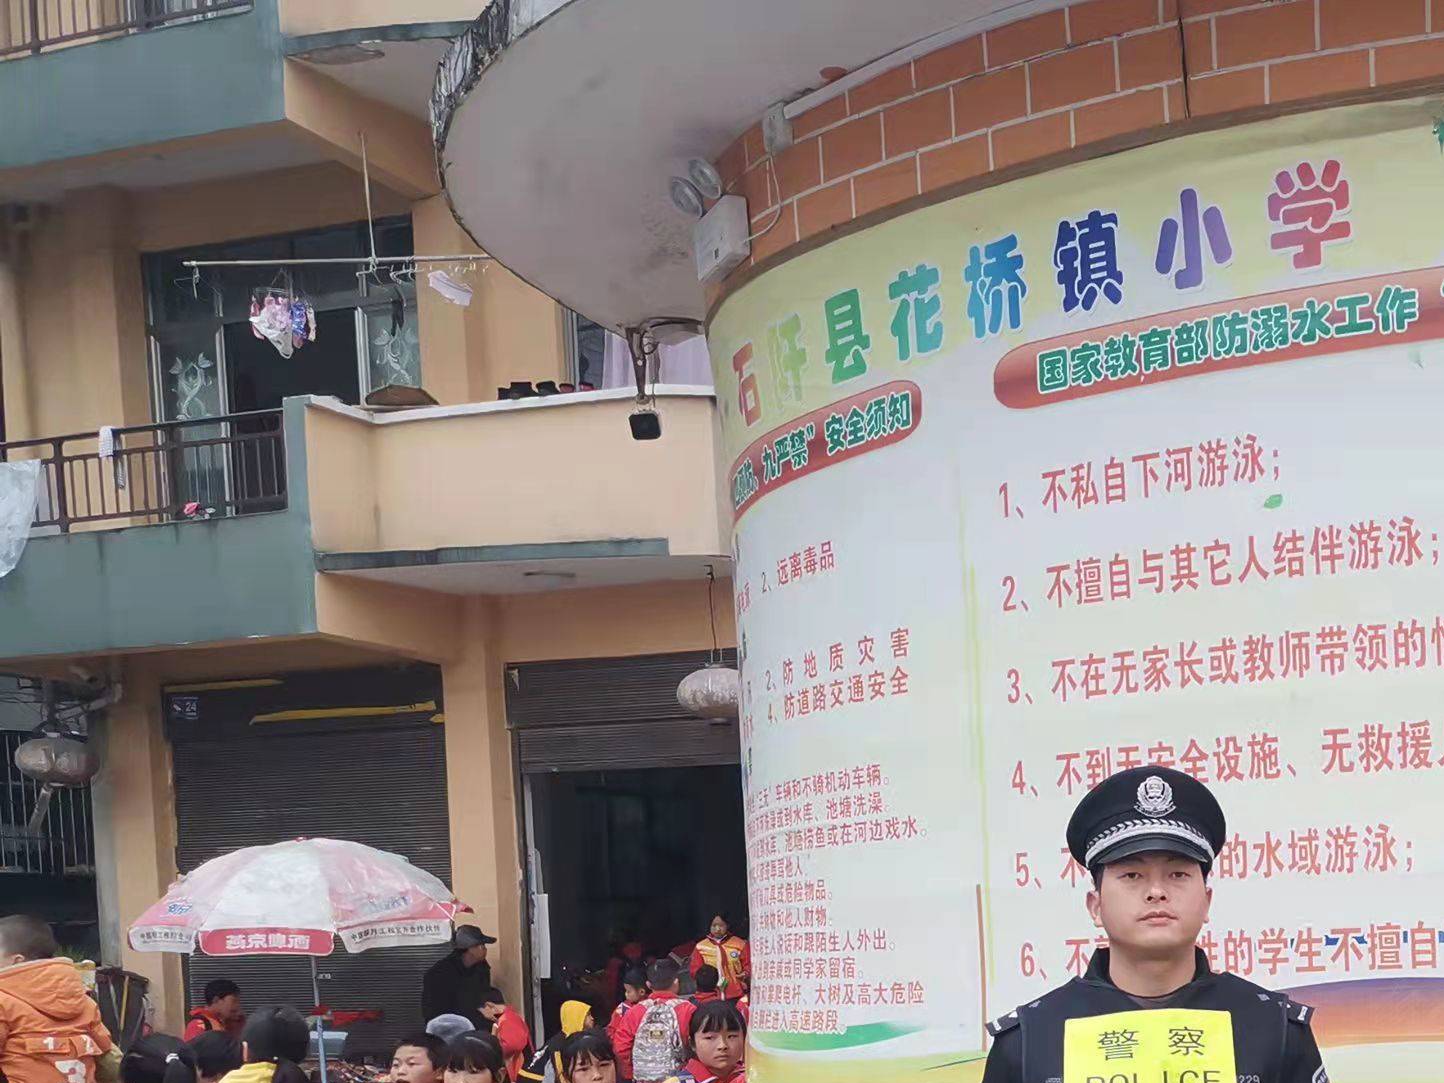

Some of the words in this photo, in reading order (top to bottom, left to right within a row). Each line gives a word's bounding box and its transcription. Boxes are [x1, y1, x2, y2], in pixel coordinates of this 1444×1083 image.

[732, 158, 1353, 428] 石阡县花桥镇小学
[998, 433, 1283, 518] 1、不私自下河游泳；
[1001, 516, 1442, 614] 2、不擅自与其它人结伴游泳；
[225, 933, 311, 951] 燕京啤酒
[1096, 1026, 1206, 1062] 警察
